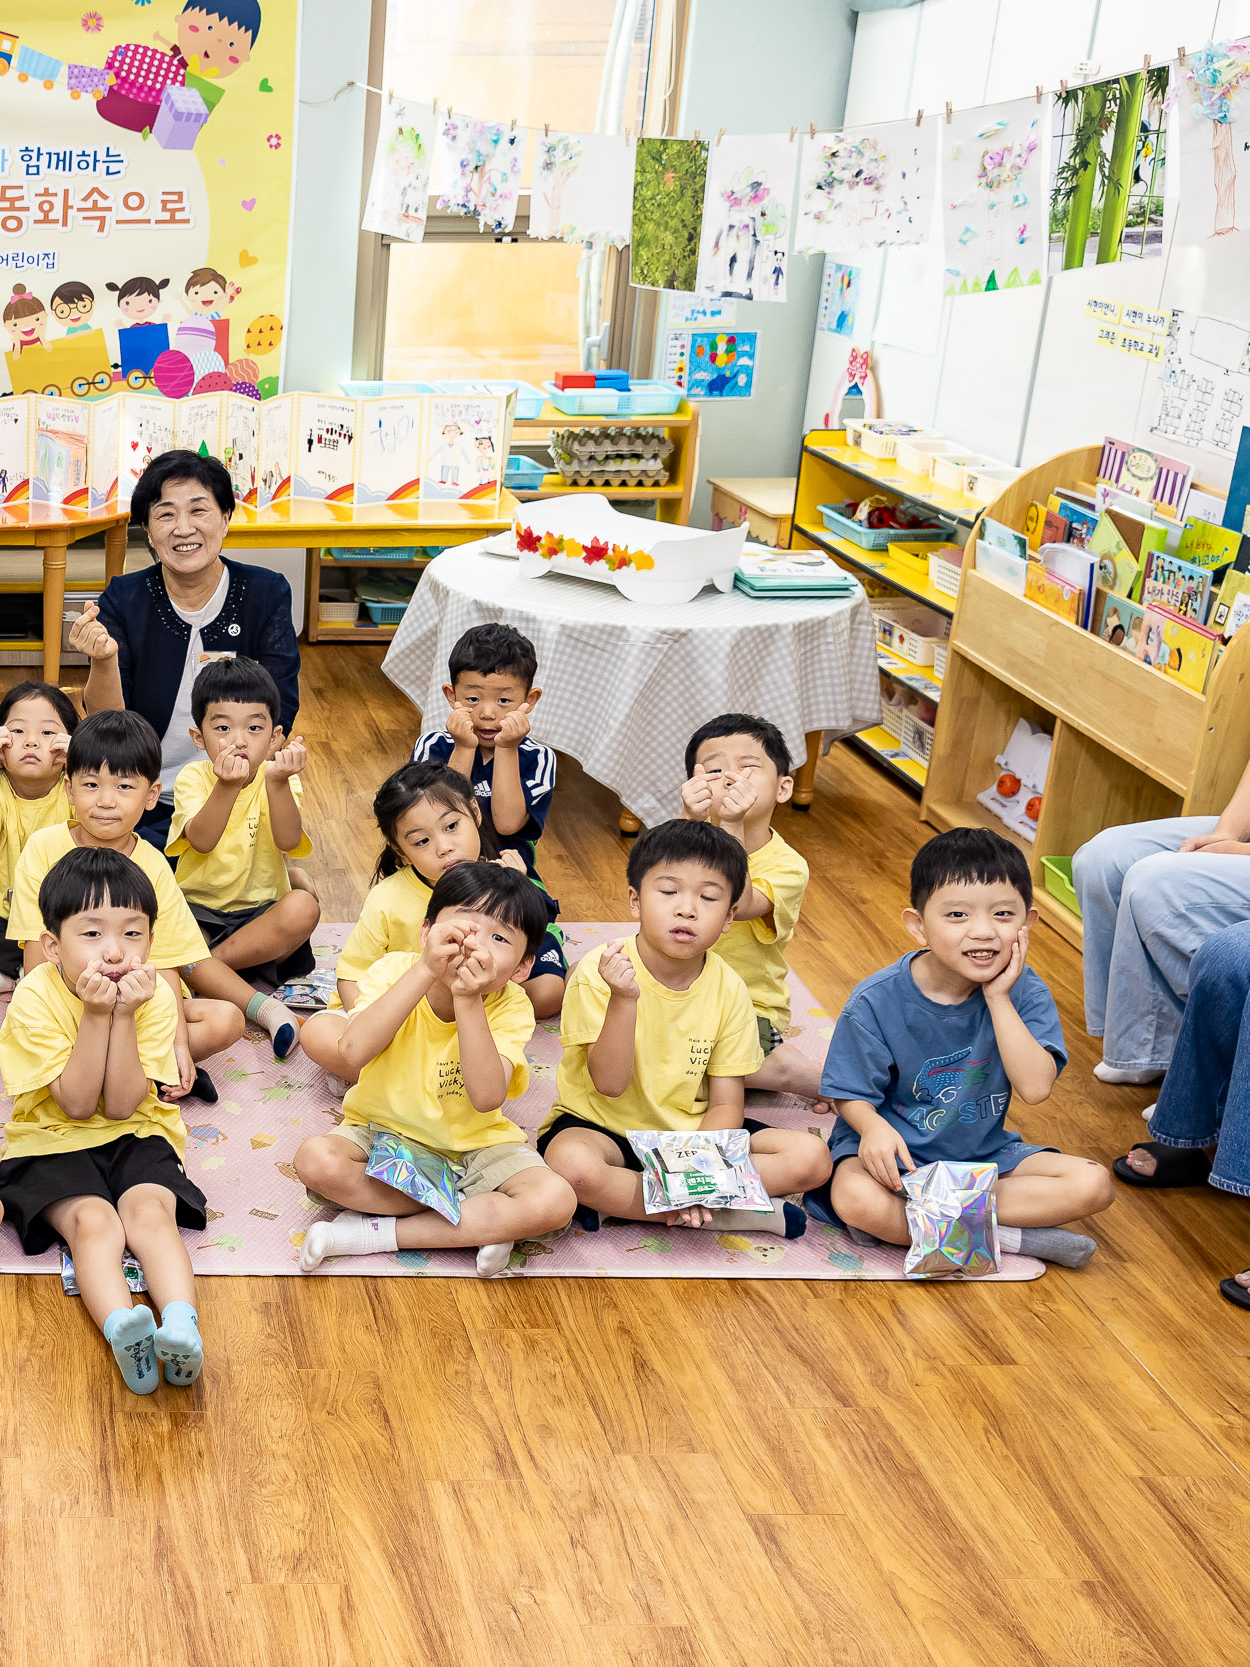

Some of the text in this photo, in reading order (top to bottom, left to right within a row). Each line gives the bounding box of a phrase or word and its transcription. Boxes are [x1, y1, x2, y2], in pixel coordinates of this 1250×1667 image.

[19, 146, 124, 176] 함께하는
[1147, 586, 1165, 599] 내가
[690, 1045, 713, 1054] Luc
[689, 1057, 708, 1066] Vic
[439, 1066, 462, 1078] Luck
[439, 1076, 465, 1089] Vicky
[676, 1150, 699, 1159] ZER
